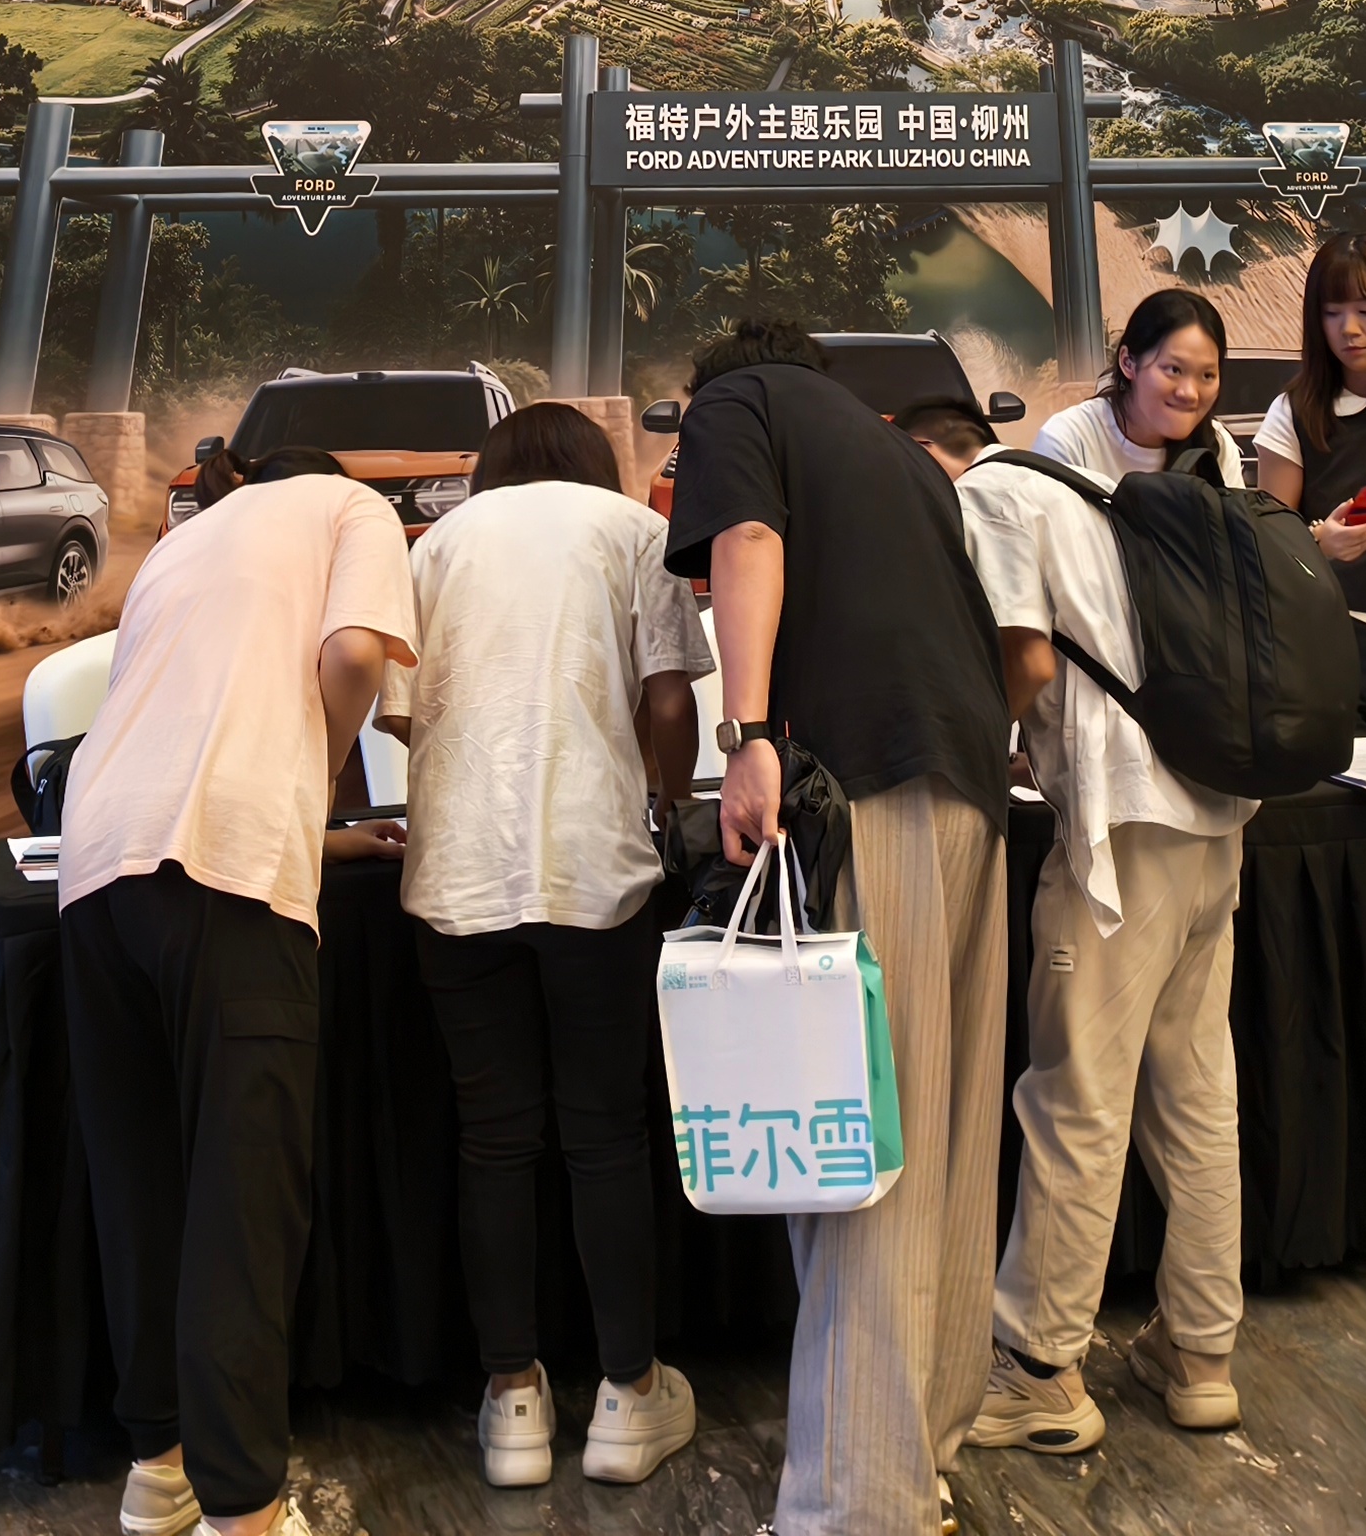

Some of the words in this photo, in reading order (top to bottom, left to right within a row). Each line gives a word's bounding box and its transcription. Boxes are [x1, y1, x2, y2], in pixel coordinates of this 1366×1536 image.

[625, 103, 883, 141] 福特户外主题乐园
[898, 103, 1029, 141] 中国·柳州
[626, 150, 683, 170] FORD
[686, 149, 814, 170] ADVENTURE
[818, 149, 874, 168] PARK
[877, 148, 966, 168] LIUZHOU
[969, 148, 1031, 167] CHINA
[295, 179, 336, 191] FORD
[1296, 172, 1329, 182] FORD
[673, 1098, 876, 1193] 菲尔雪
